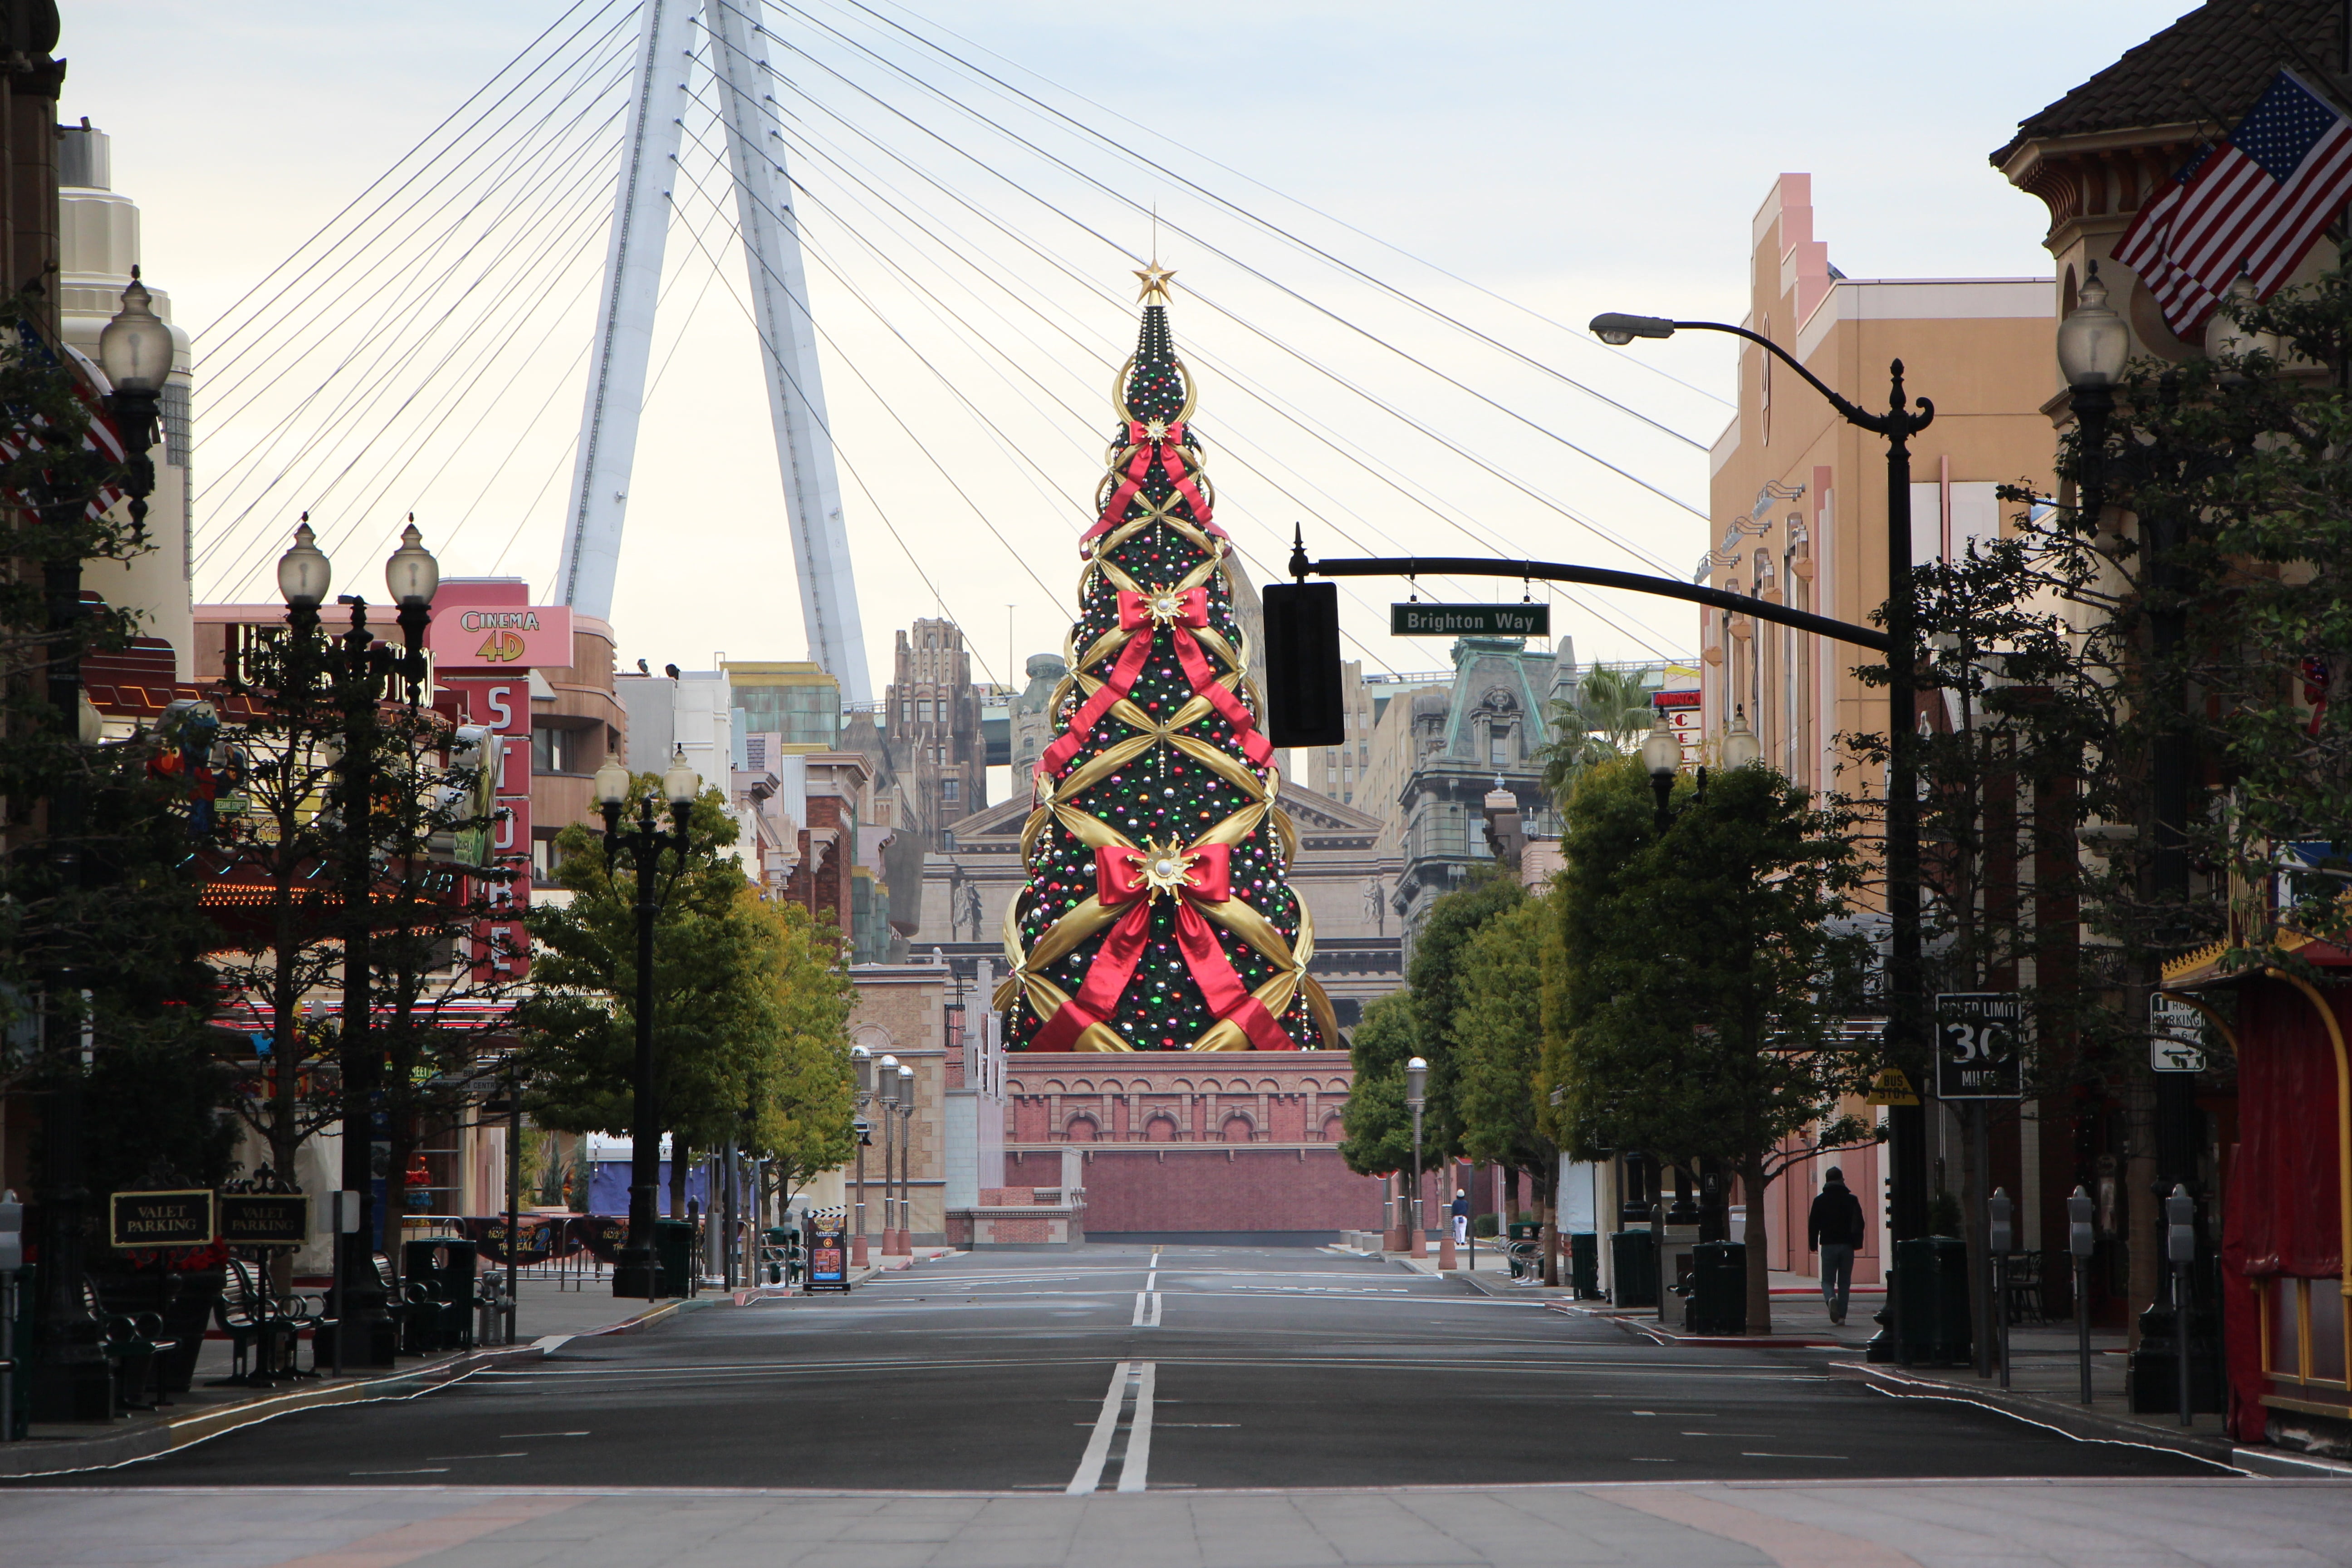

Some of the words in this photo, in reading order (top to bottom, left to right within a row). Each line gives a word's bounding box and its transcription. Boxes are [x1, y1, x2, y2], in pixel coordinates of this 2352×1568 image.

[461, 611, 539, 632] CINEMA
[1407, 612, 1485, 632] Brighton
[1495, 613, 1534, 632] Way
[475, 630, 524, 662] 4-D
[1983, 1001, 2015, 1017] LIMIT
[2156, 1015, 2200, 1025] PRKING
[1884, 1075, 1903, 1086] BUS
[137, 1205, 186, 1219] VALET
[242, 1207, 286, 1219] VALET
[127, 1219, 196, 1232] PARKING
[232, 1219, 294, 1231] PARKING
